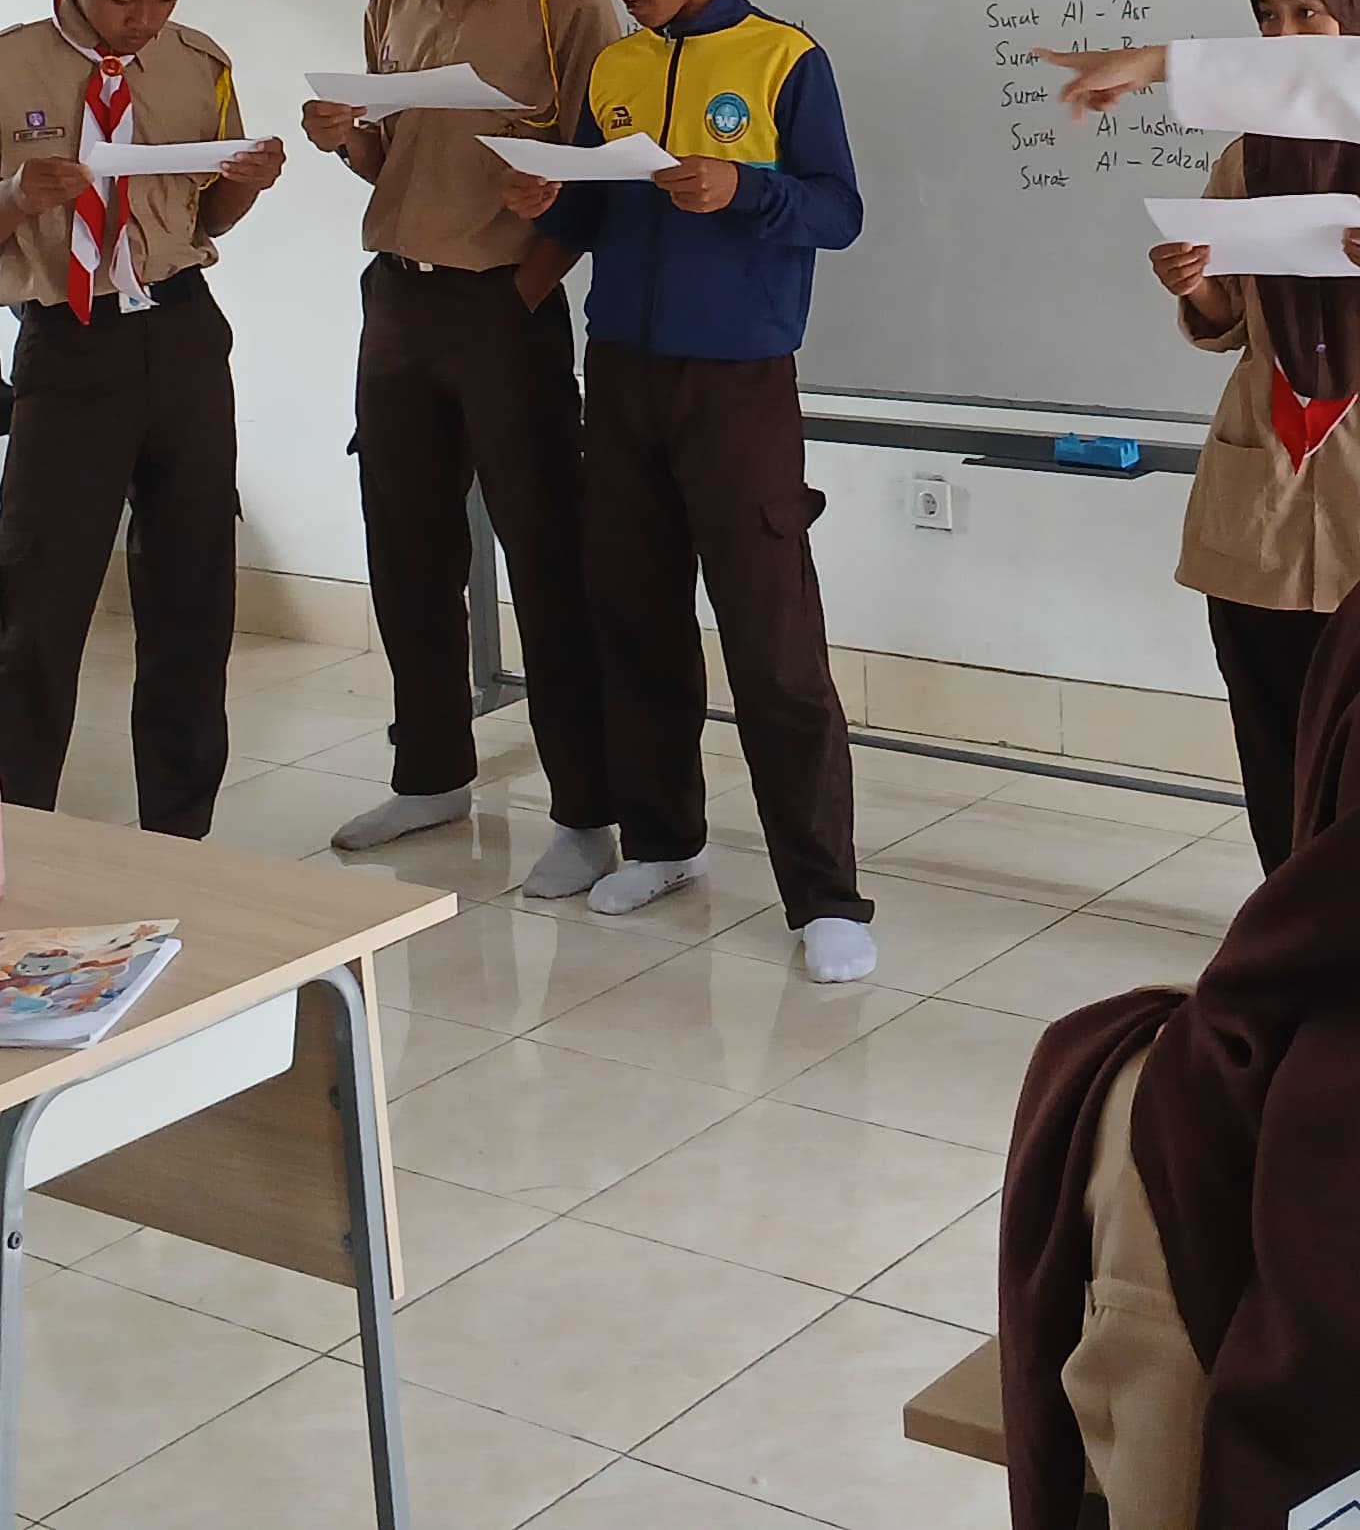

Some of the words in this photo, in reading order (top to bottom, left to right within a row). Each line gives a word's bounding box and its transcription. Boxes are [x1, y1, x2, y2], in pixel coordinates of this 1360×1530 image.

[985, 3, 1040, 29] Surat
[1001, 81, 1048, 108] Surat
[1011, 122, 1056, 151] Surat
[1020, 165, 1070, 190] Surat
